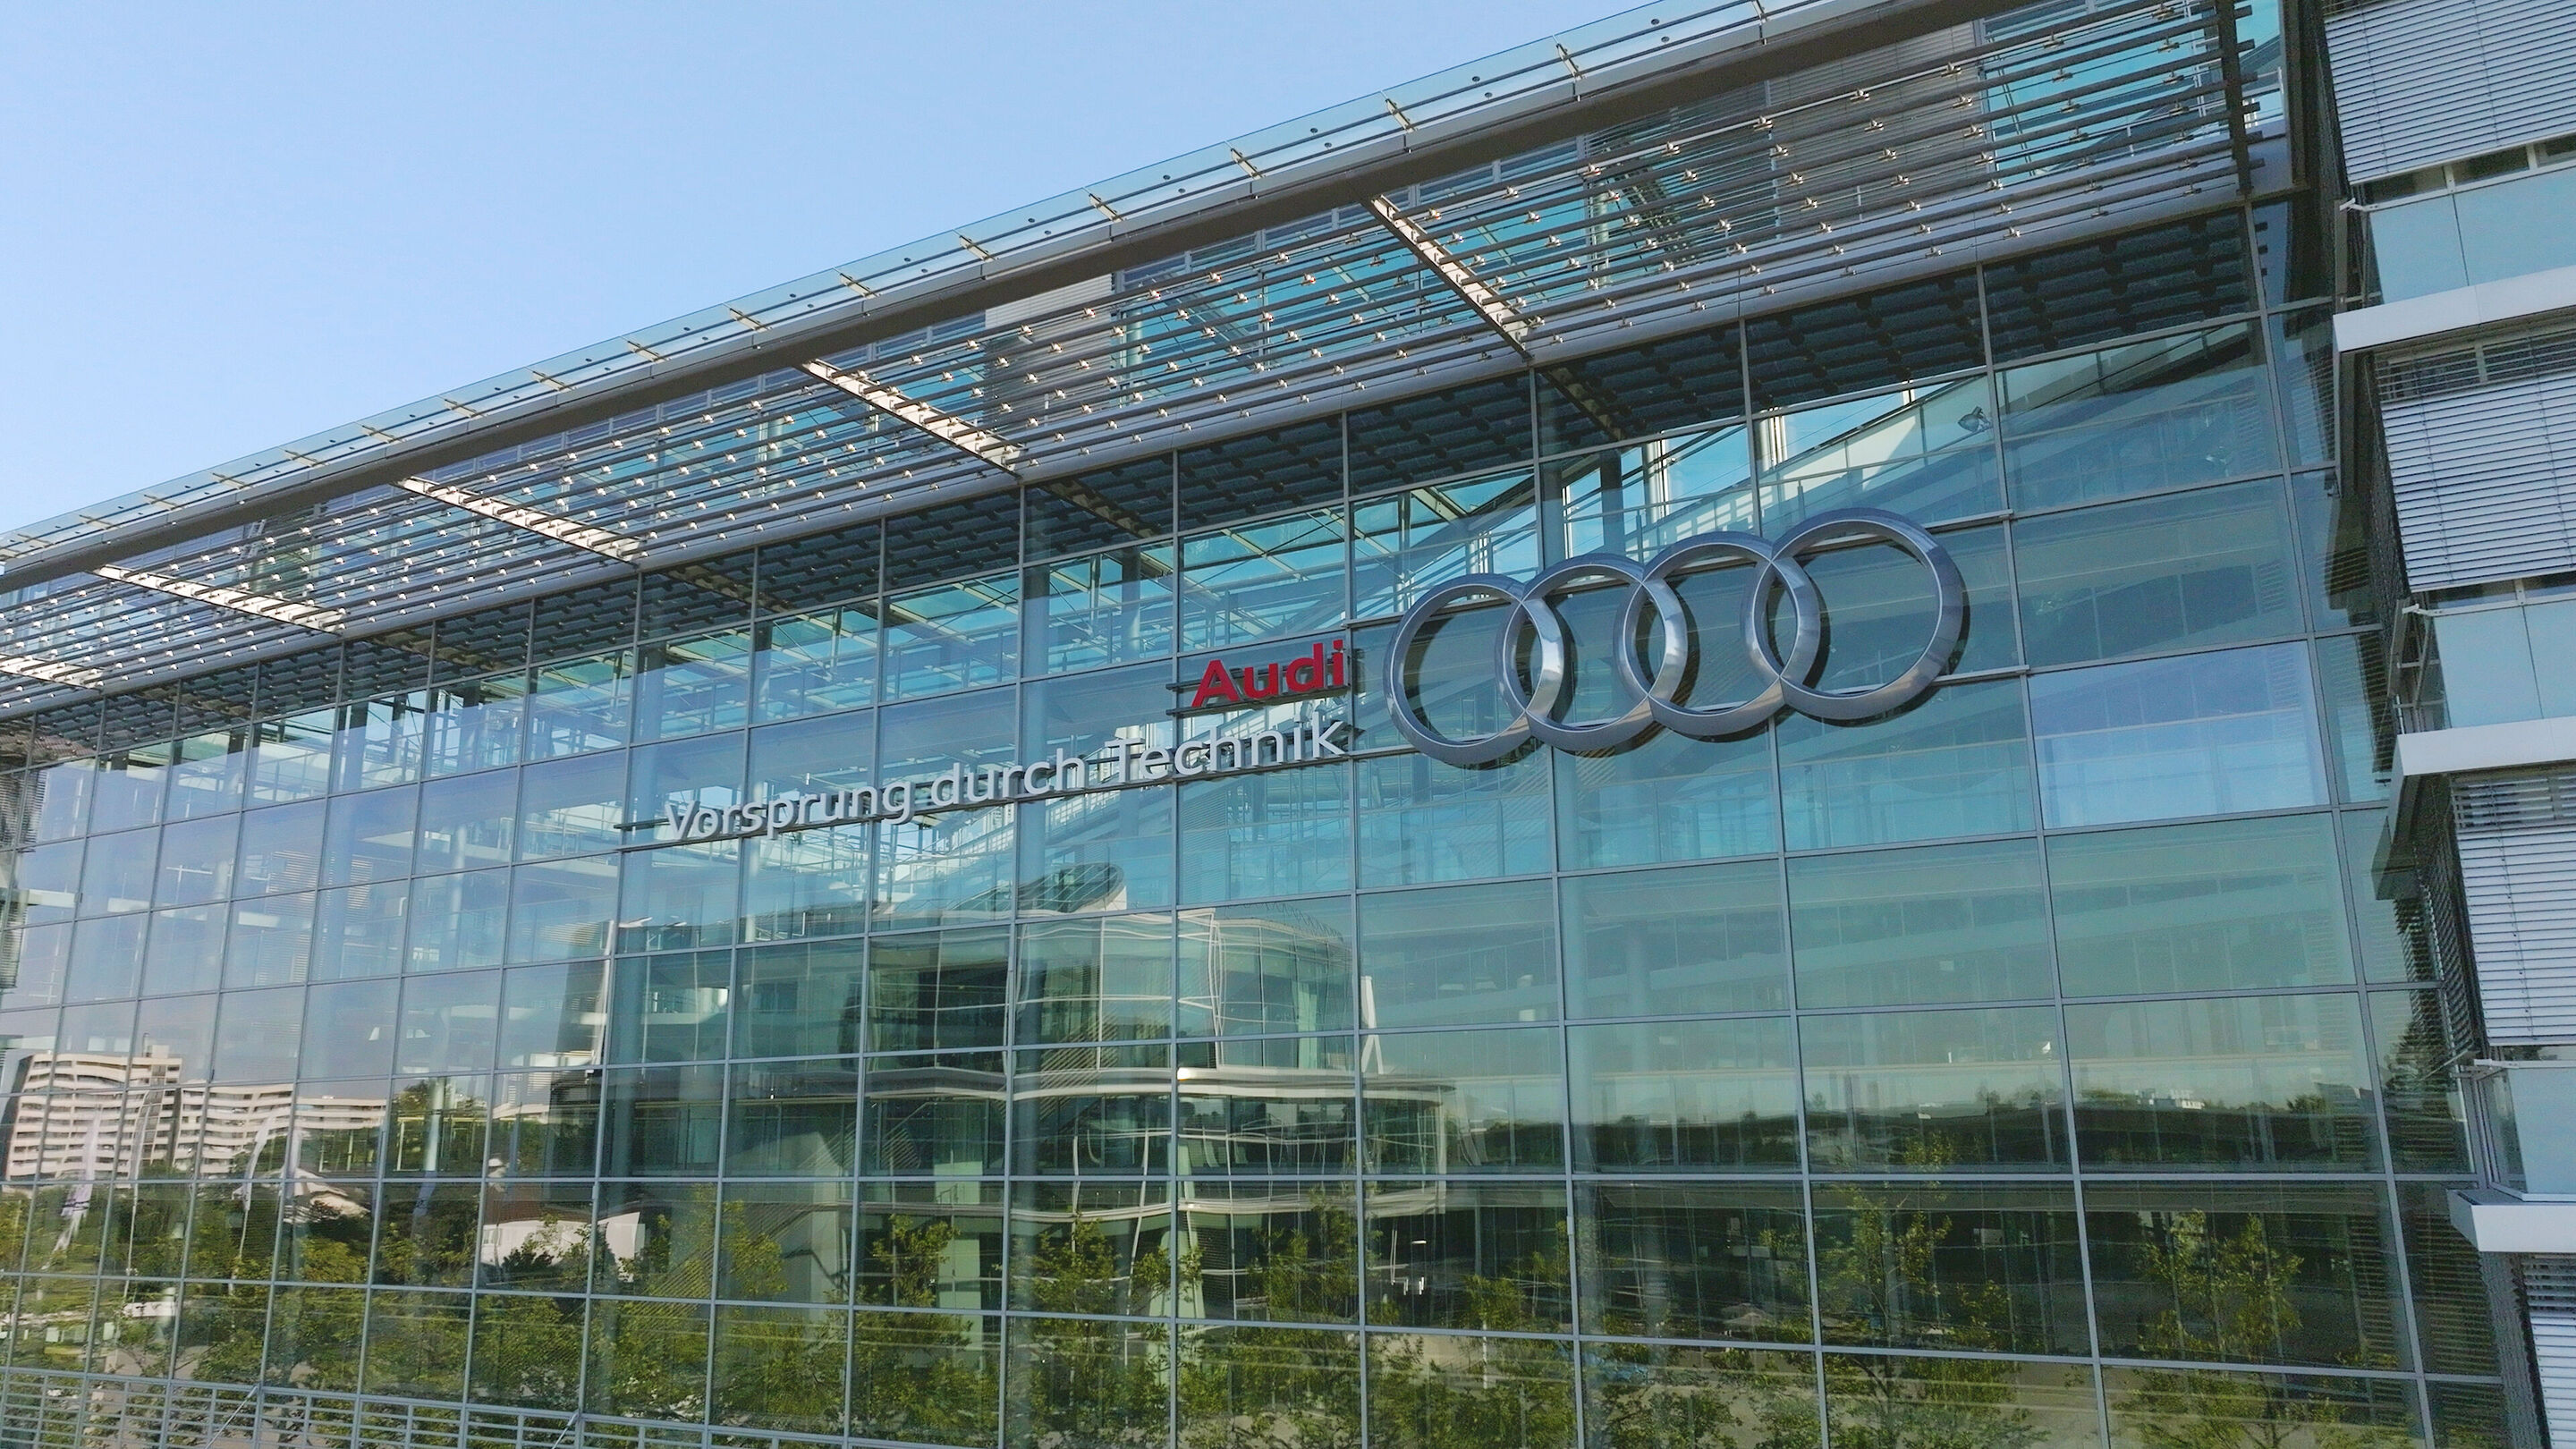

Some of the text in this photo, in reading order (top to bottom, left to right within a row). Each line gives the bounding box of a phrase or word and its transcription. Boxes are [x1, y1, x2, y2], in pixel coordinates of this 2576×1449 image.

[1191, 640, 1347, 708] Audi
[665, 711, 1345, 841] Vorsprung durch Technik
